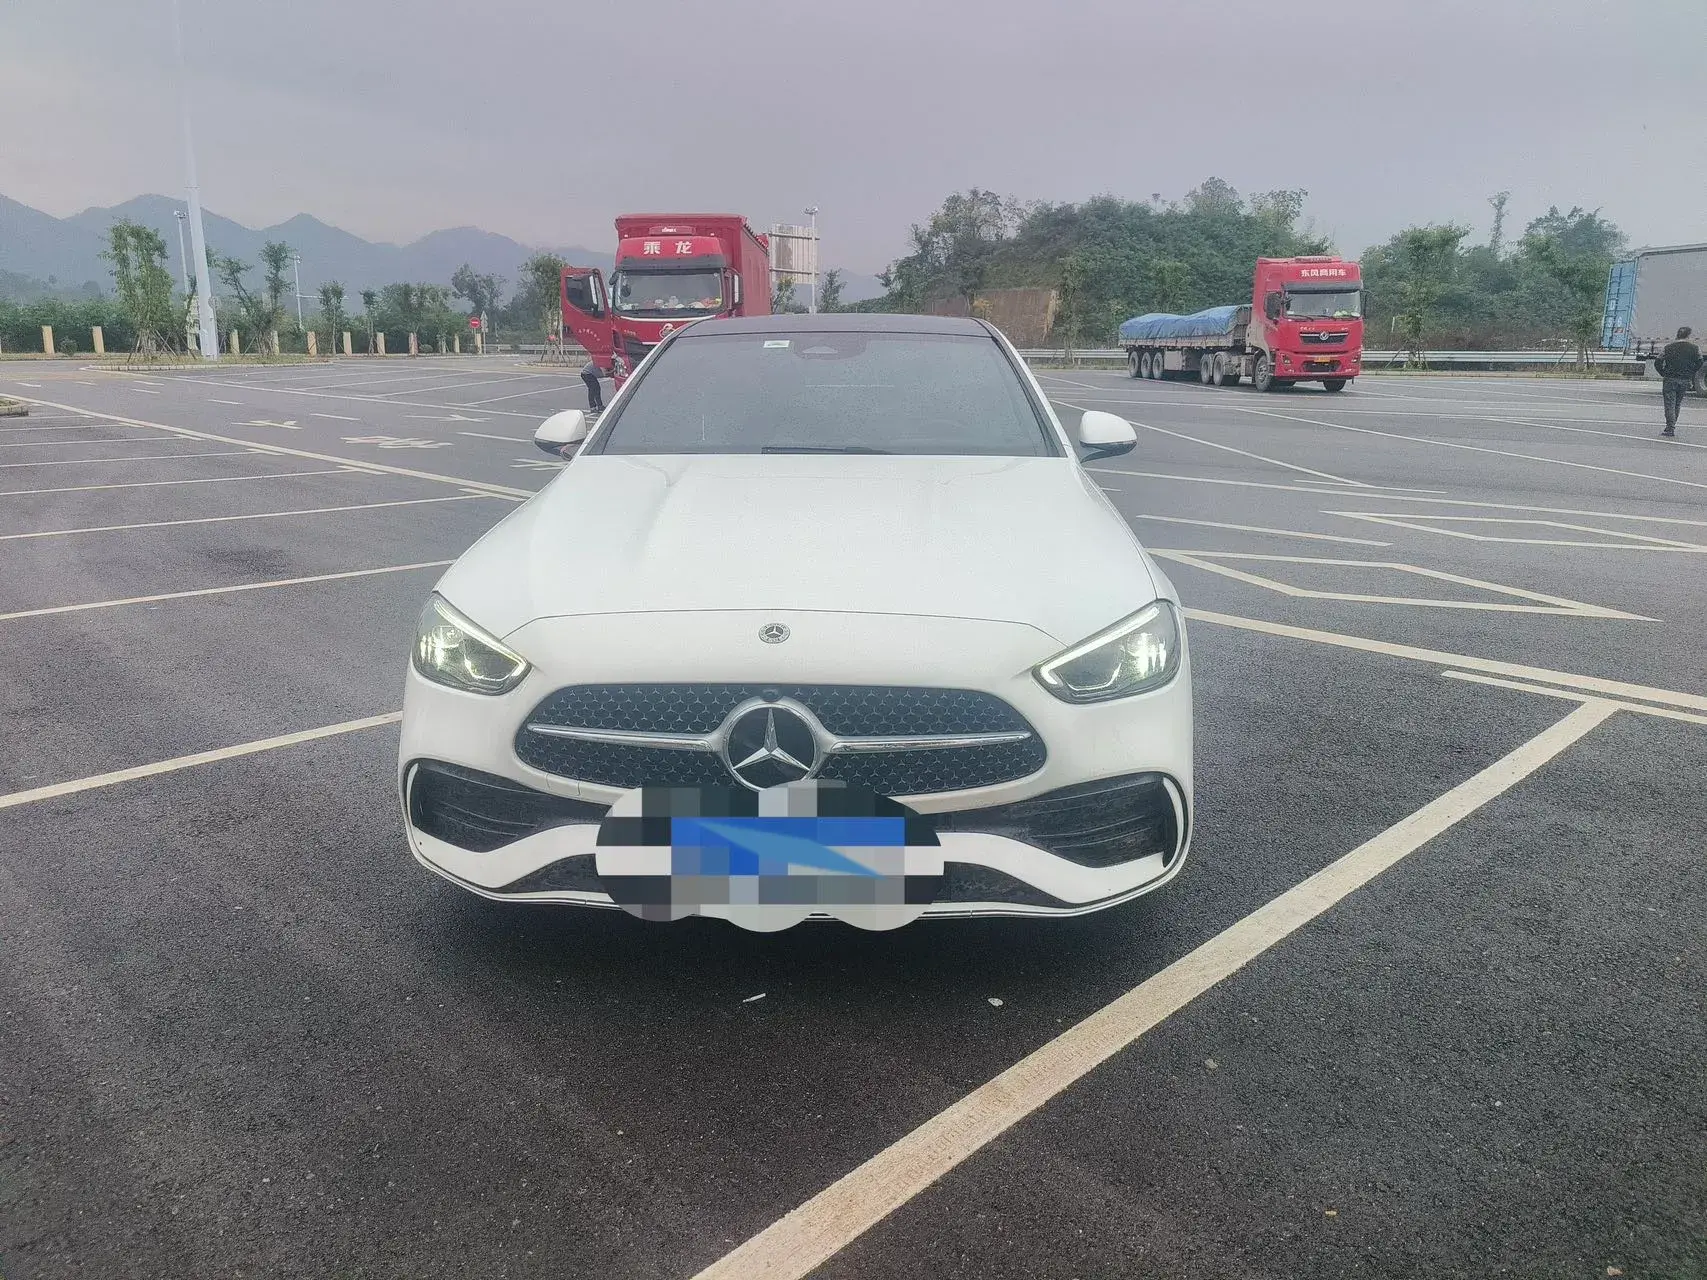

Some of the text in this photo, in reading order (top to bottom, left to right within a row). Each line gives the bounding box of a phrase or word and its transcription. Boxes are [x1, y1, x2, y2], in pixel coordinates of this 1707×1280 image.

[643, 241, 692, 254] 乘龙
[1301, 268, 1347, 277] 东风商用车
